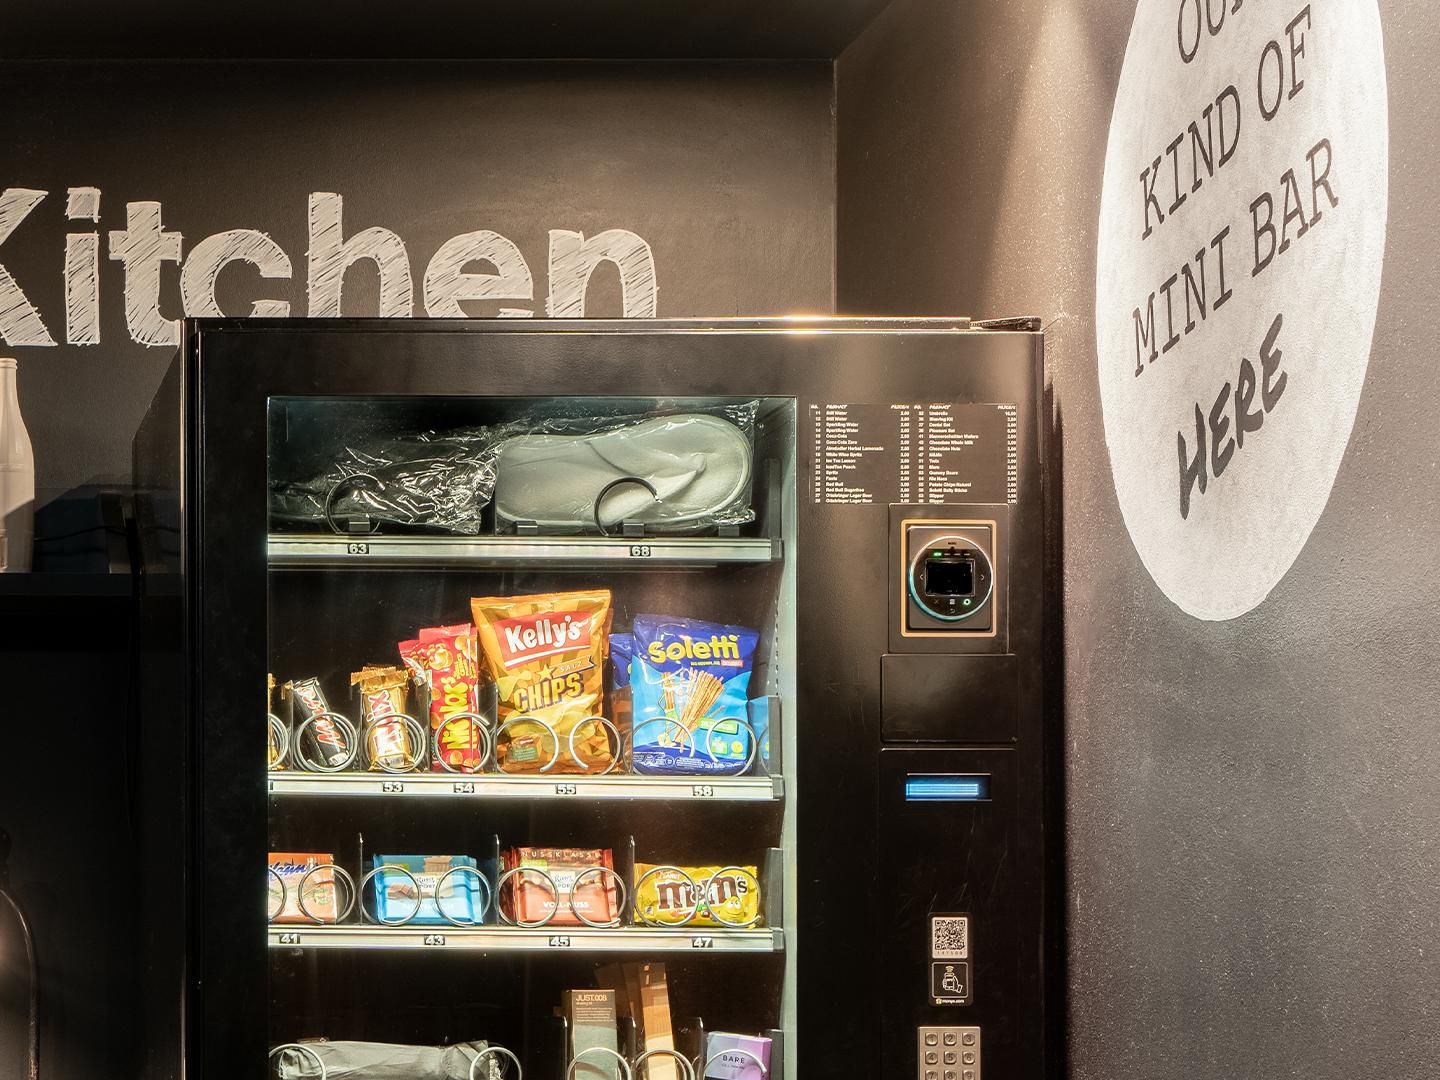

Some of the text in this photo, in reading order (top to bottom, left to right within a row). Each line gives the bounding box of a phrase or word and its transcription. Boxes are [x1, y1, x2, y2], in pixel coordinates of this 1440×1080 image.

[1177, 0, 1243, 64] OU
[1139, 5, 1313, 241] KIND OF
[1132, 137, 1339, 378] MINI BAR
[1176, 312, 1289, 520] HERE
[349, 544, 650, 557] 63 68
[504, 615, 582, 653] Kelly's
[513, 672, 584, 714] CHIPS
[384, 782, 712, 796] 53 54 55 58
[280, 934, 711, 947] 41 43 45 47
[722, 1055, 745, 1063] BARE
